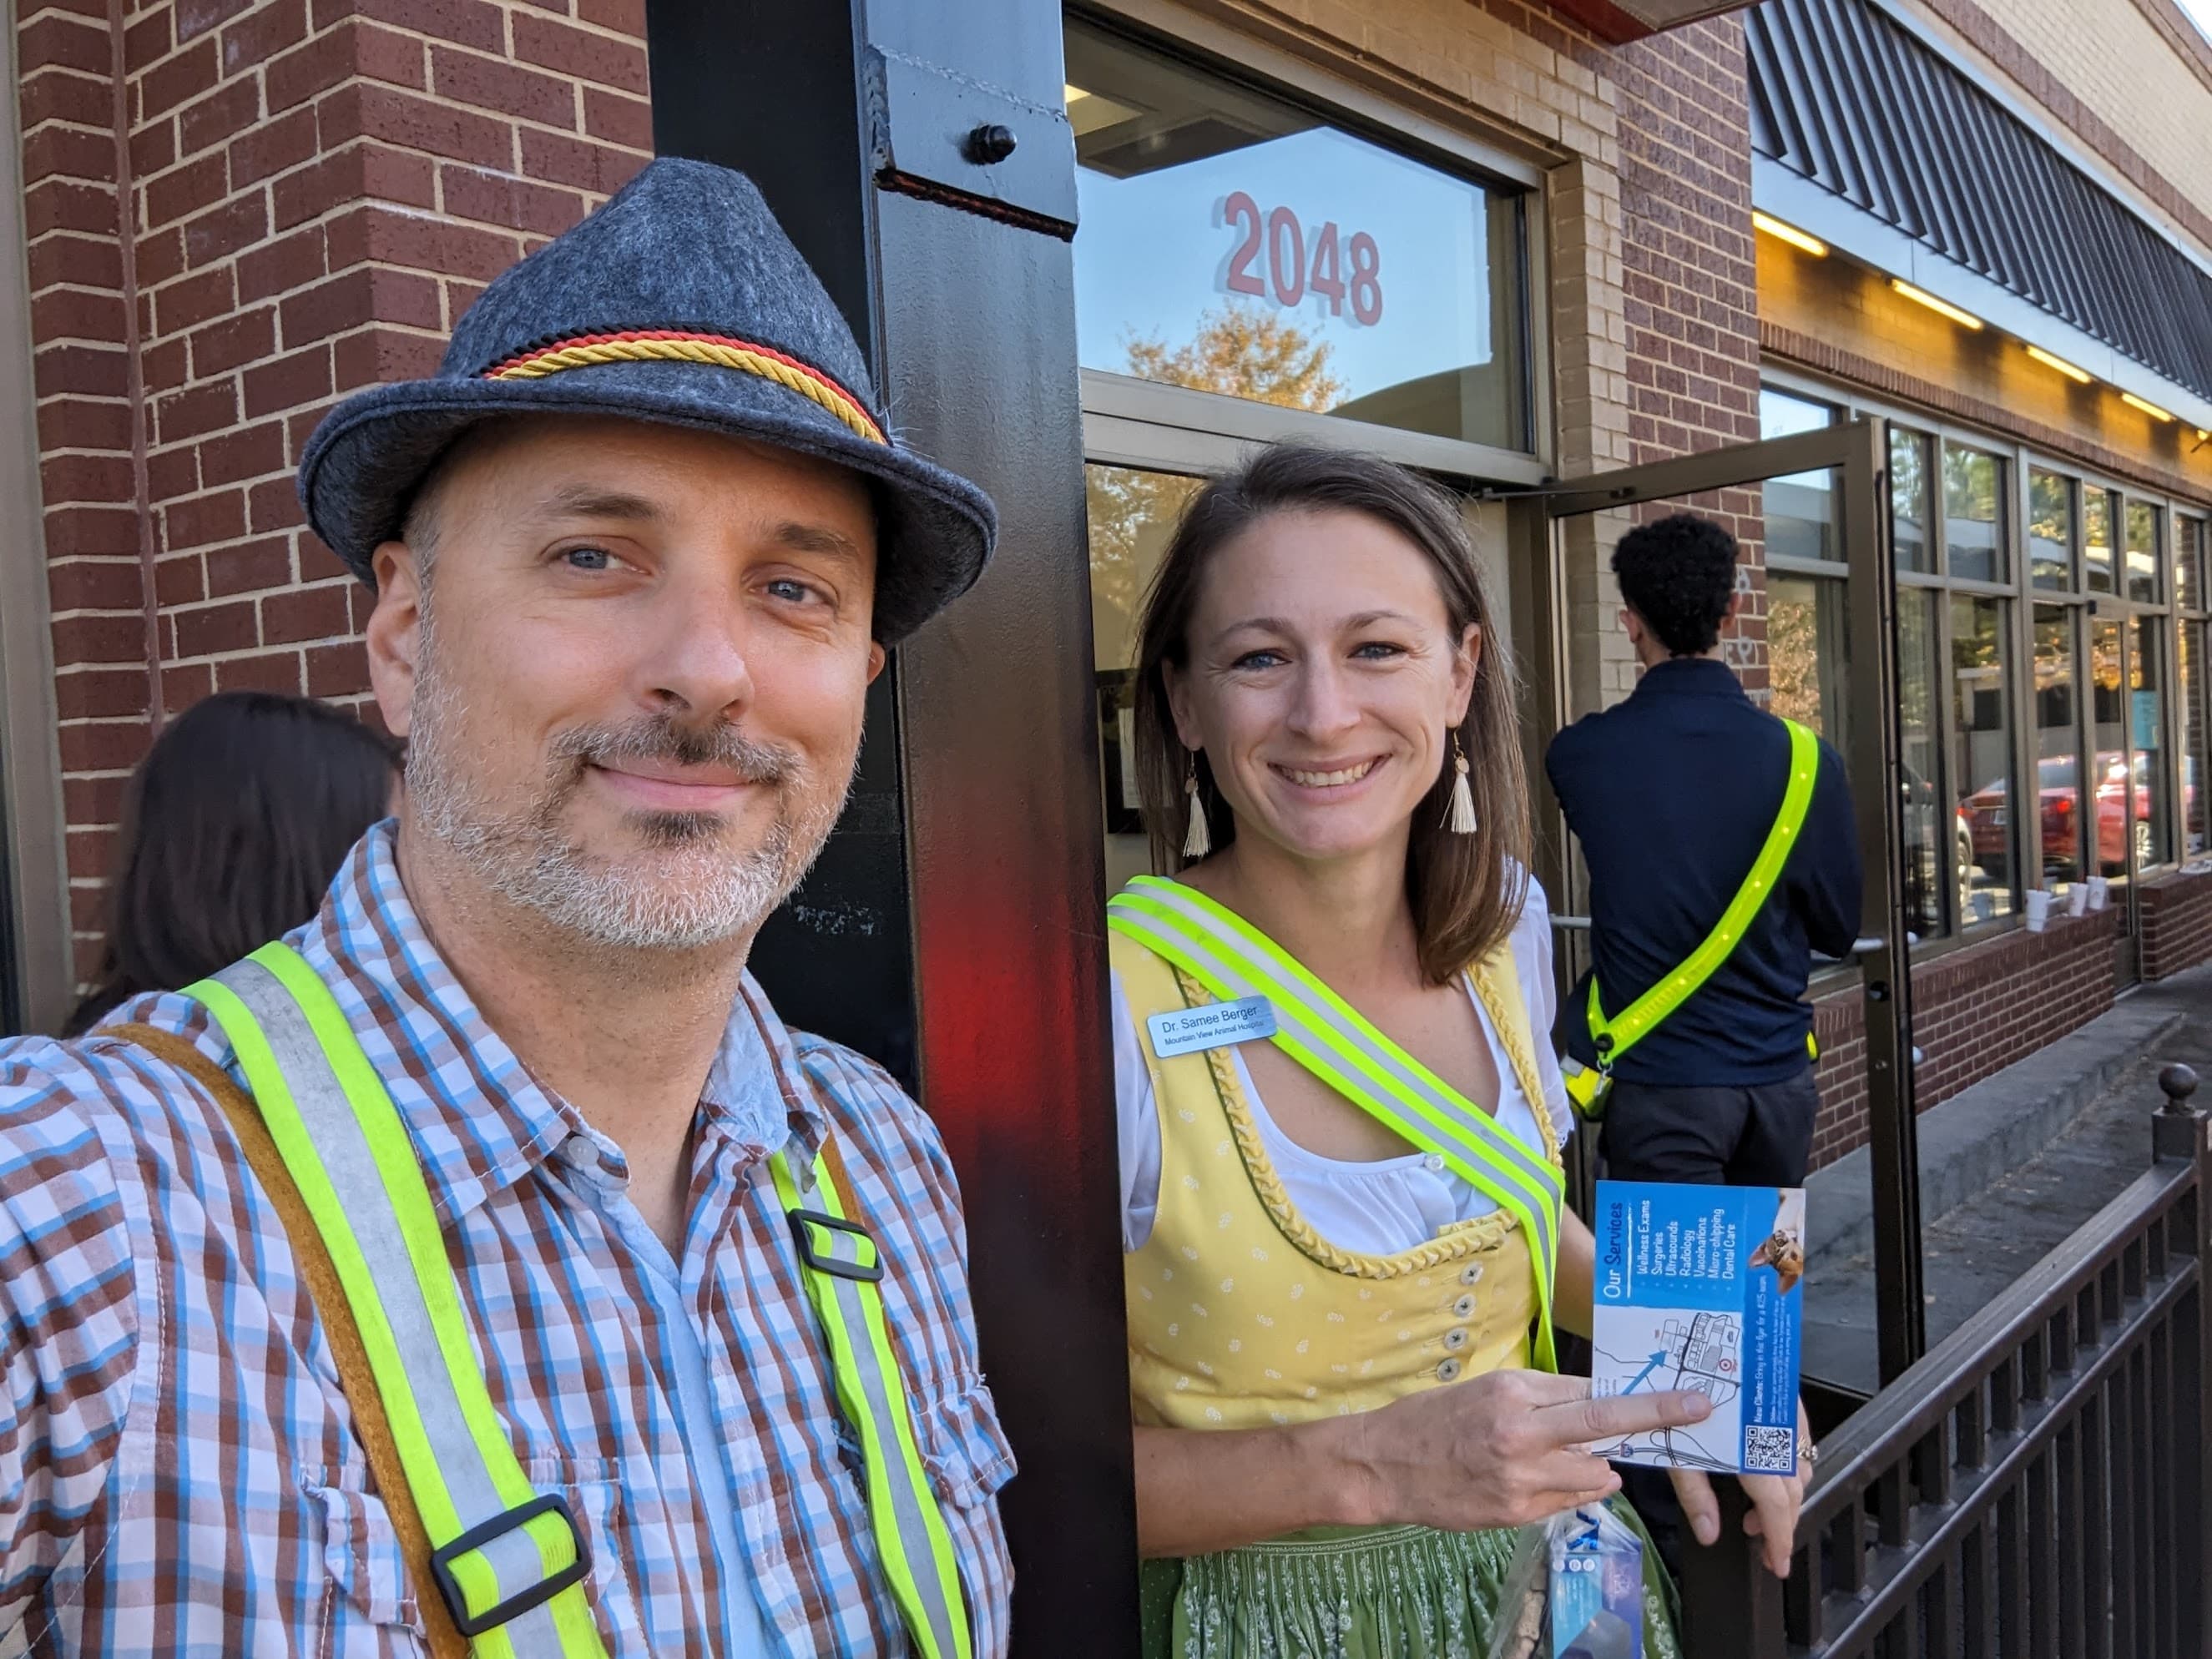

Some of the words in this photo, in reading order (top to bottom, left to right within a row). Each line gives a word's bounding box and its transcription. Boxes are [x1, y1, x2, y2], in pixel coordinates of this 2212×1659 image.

[1225, 191, 1382, 327] 2048
[1162, 1021, 1179, 1034] Dr.
[1180, 1014, 1220, 1030] Samee
[1220, 1006, 1258, 1021] Berger
[1164, 1034, 1196, 1046] Mountain
[1196, 1031, 1213, 1040] View
[1214, 1026, 1237, 1036] Animal
[1603, 1202, 1623, 1266] Services
[1637, 1199, 1650, 1233] Exams
[1723, 1223, 1736, 1248] Care
[1636, 1234, 1649, 1275] Wellness
[1651, 1231, 1666, 1276] Surgeries
[1664, 1220, 1679, 1277] Ultrasounds
[1679, 1229, 1695, 1277] Radiology
[1693, 1216, 1708, 1278] Vaccinations
[1707, 1208, 1725, 1279] Micro-chipping
[1722, 1248, 1735, 1280] Dental
[1603, 1269, 1621, 1298] Our
[1754, 1407, 1763, 1423] New
